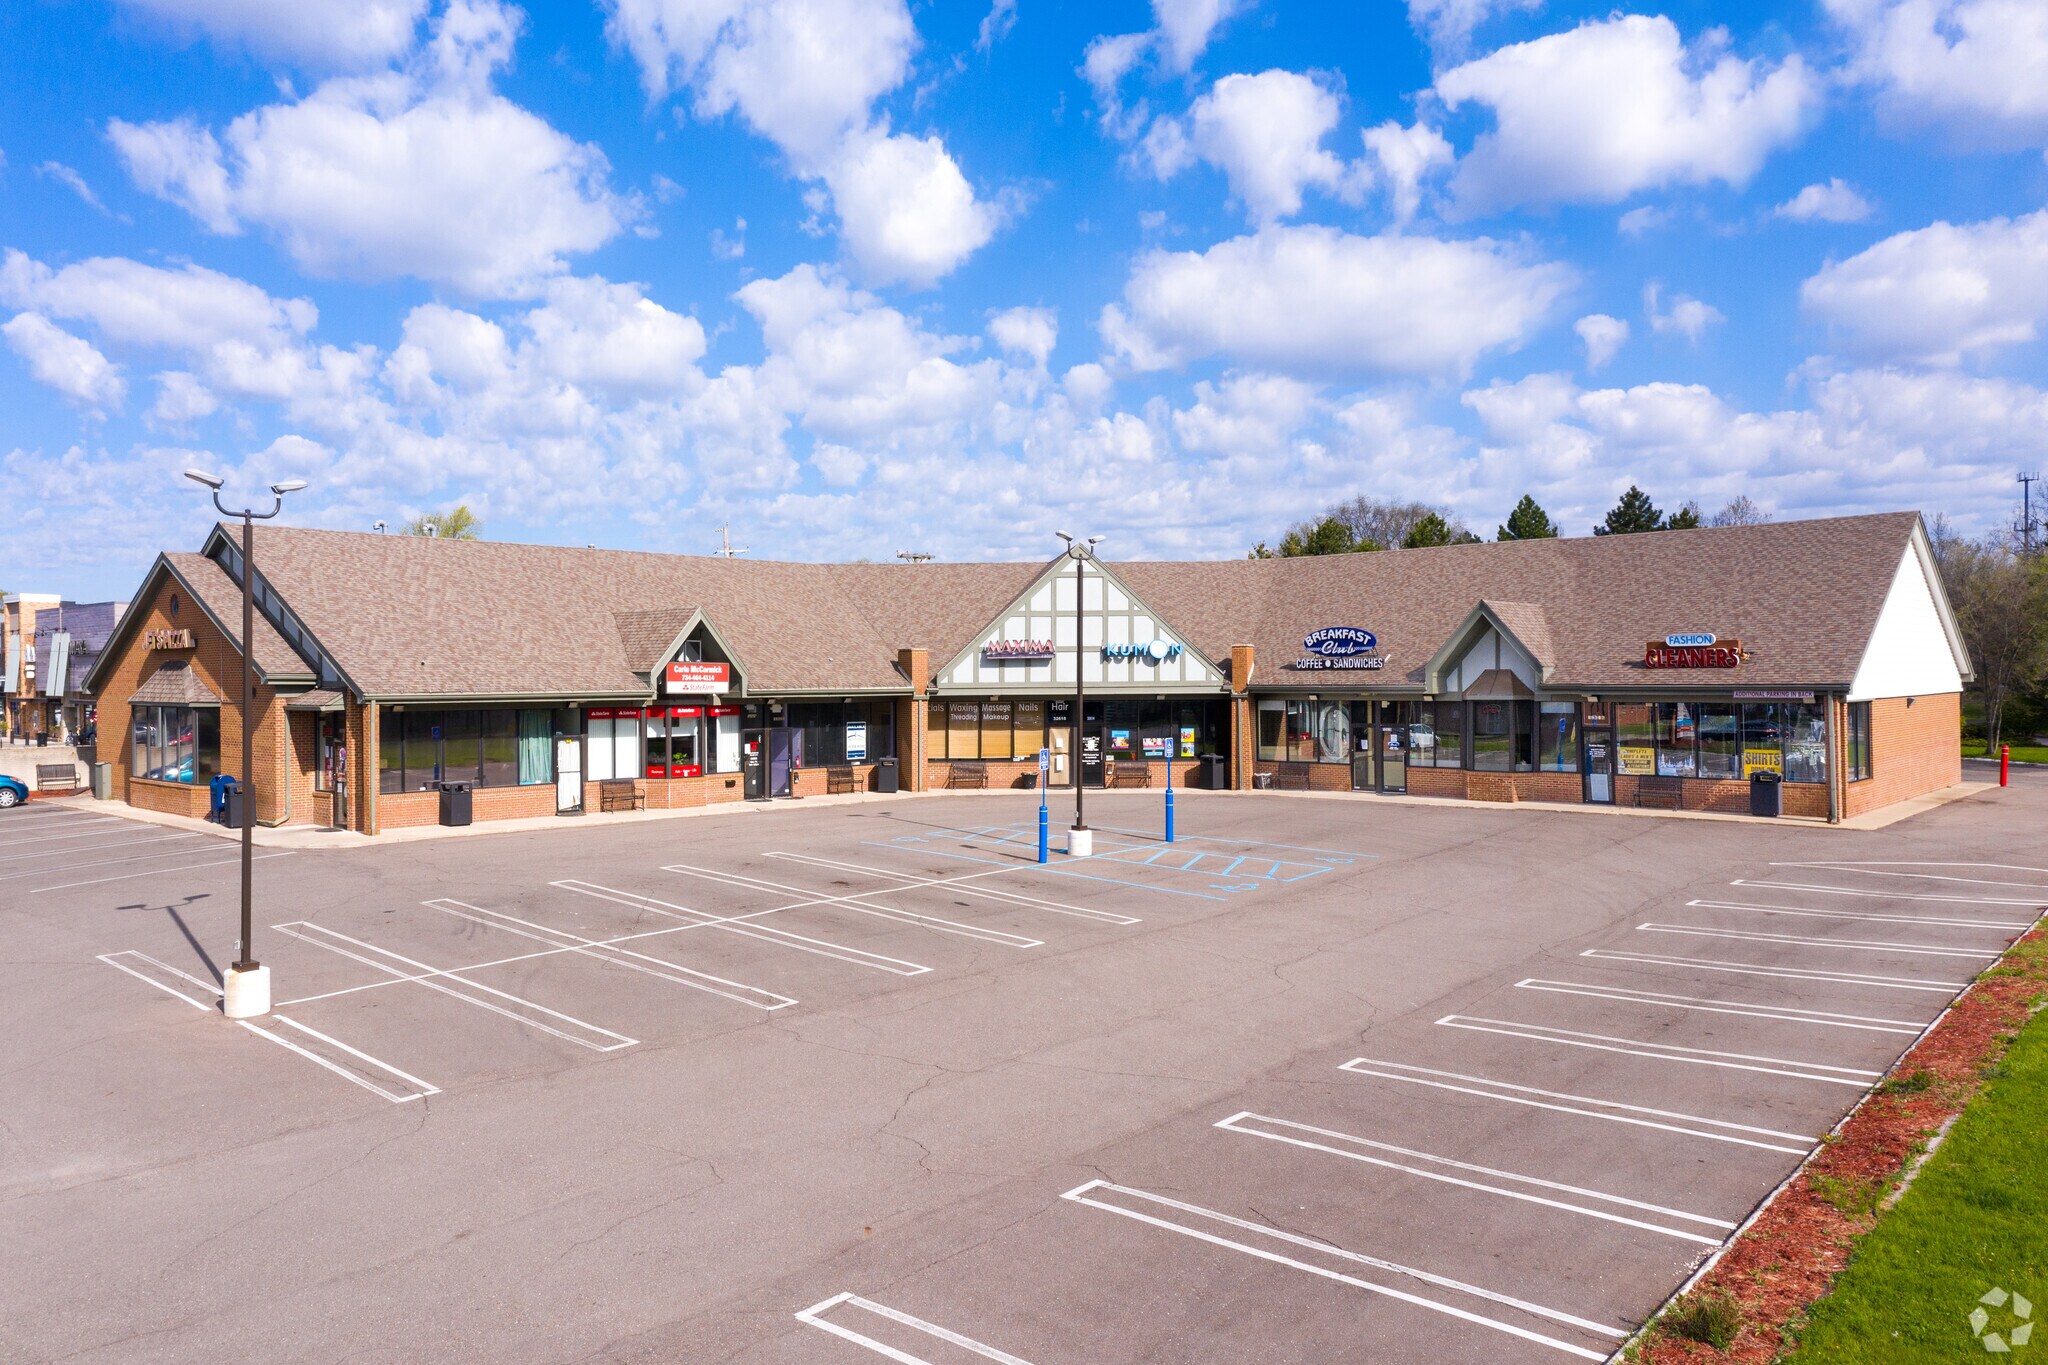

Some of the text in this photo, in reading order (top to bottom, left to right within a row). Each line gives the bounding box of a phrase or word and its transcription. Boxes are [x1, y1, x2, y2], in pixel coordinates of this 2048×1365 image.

[163, 629, 190, 649] PIZZA
[1305, 629, 1372, 647] BREAKFAST
[1668, 635, 1712, 645] FASHION
[987, 639, 1055, 653] MAXIMA
[1105, 640, 1185, 659] KUMON
[1321, 641, 1356, 654] Club
[1296, 658, 1383, 669] COFFEE SANDWICHES
[1645, 647, 1740, 668] CLEANERS
[674, 665, 723, 673] Carla McCormick
[928, 702, 1069, 713] cials Waxing Massage Nails Hair
[951, 713, 1010, 721] Threading Makeup
[1745, 752, 1780, 766] SHIRTS
